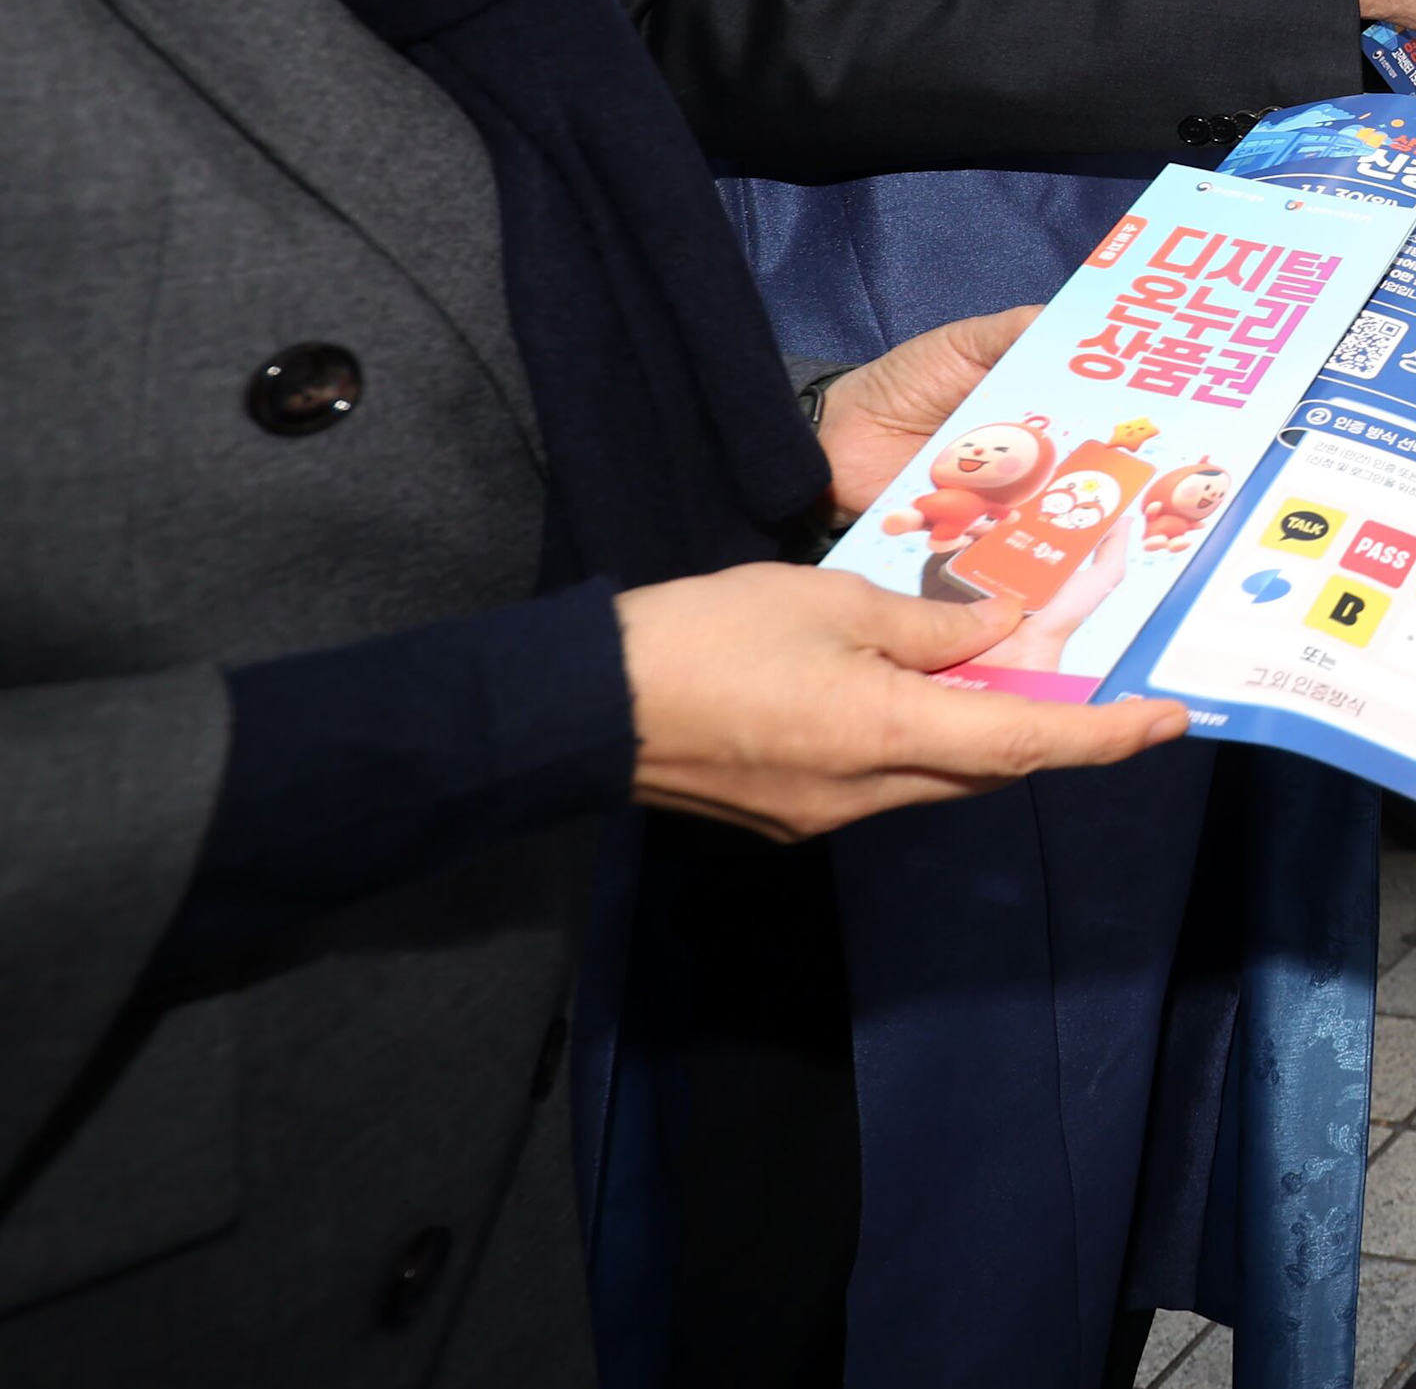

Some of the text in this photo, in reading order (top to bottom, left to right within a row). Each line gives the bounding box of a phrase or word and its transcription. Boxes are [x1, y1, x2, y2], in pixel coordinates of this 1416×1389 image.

[1146, 225, 1345, 305] 디지털
[1105, 274, 1311, 355] 온누리
[1067, 323, 1277, 409] 상품권
[1333, 415, 1363, 436] 인증
[1364, 426, 1397, 446] 방식
[1287, 515, 1325, 538] TALK
[1353, 536, 1411, 570] PASS
[1299, 645, 1337, 672] 또는
[1290, 675, 1368, 719] 인증방식
